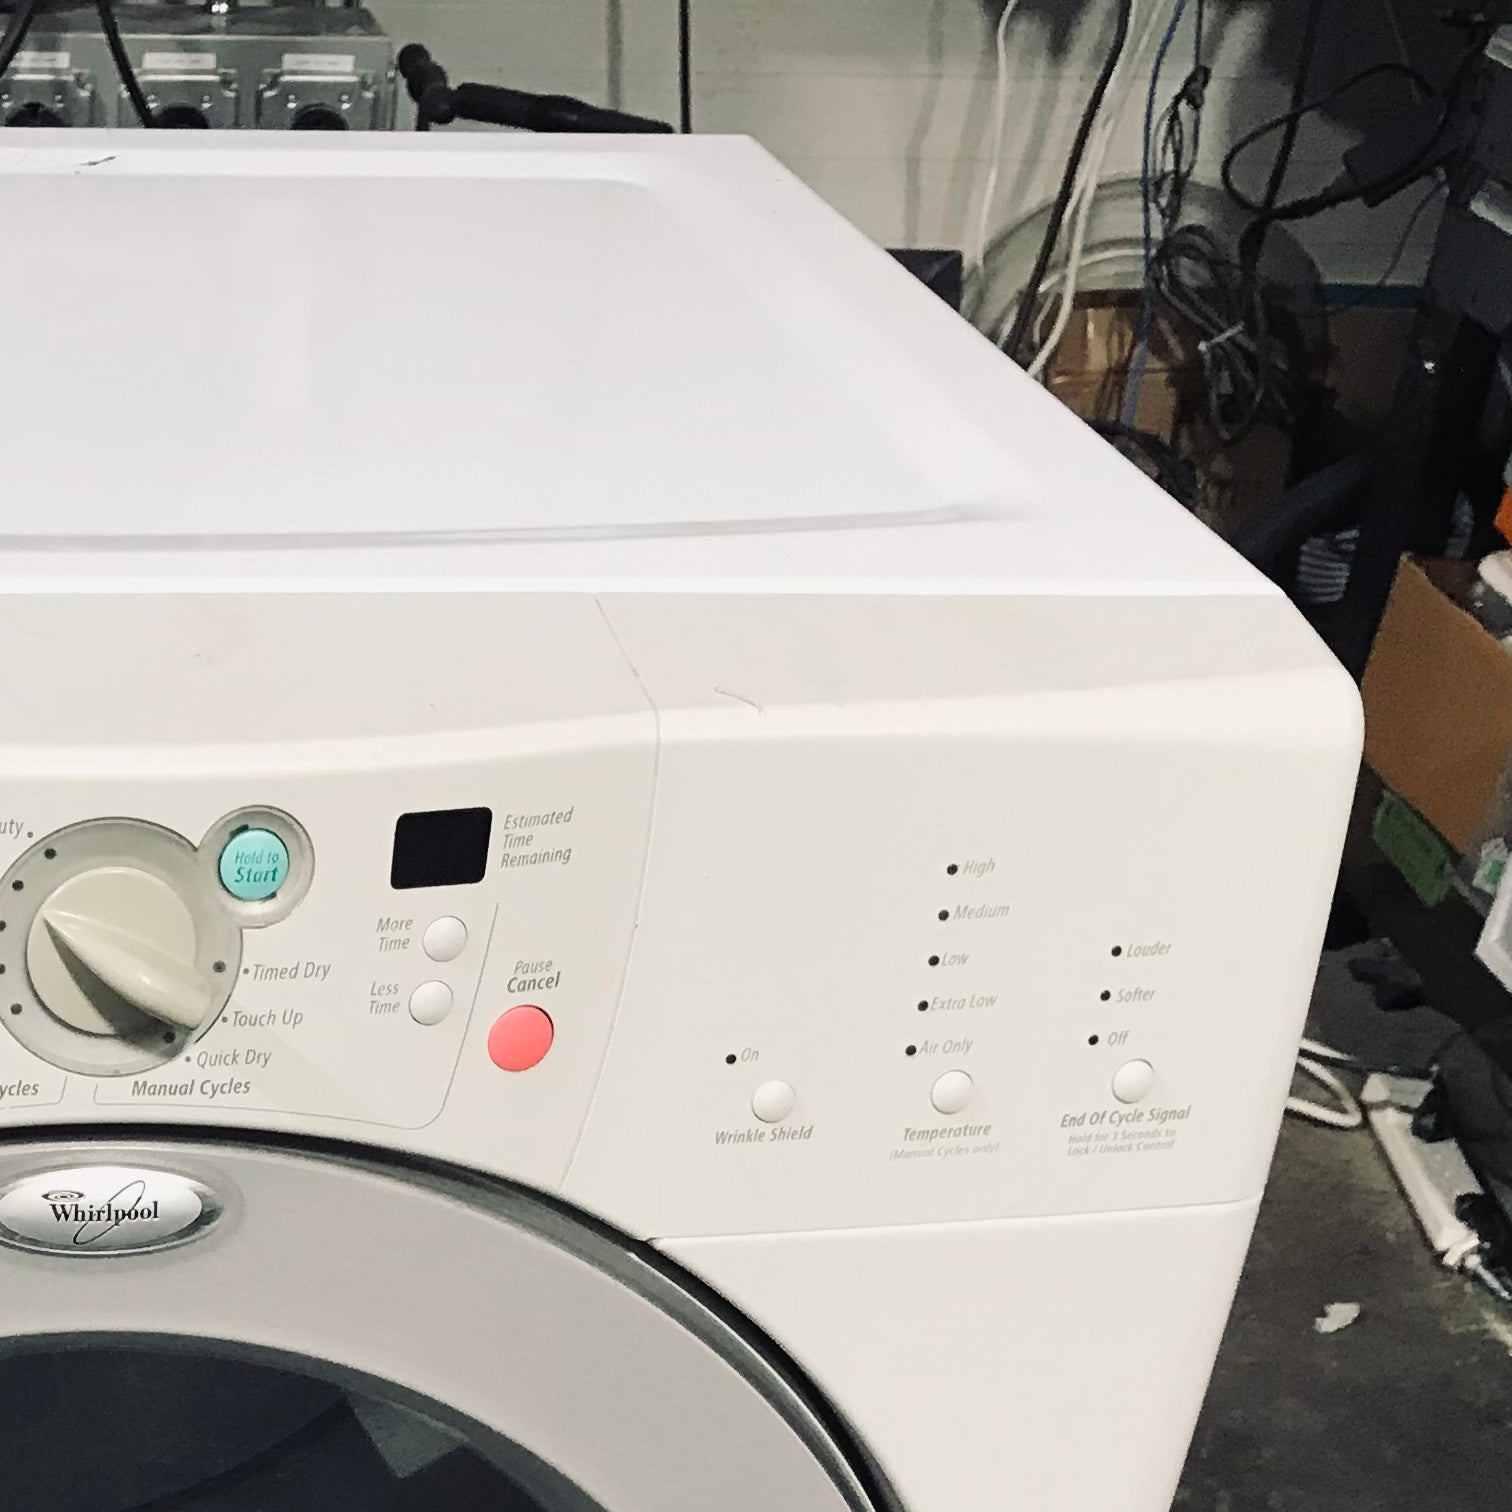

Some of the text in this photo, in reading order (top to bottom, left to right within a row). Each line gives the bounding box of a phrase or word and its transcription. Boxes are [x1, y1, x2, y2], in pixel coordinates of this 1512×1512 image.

[504, 806, 574, 830] Estimated
[503, 832, 533, 848] Time
[234, 851, 279, 865] Hold to
[500, 847, 572, 868] Remaining
[234, 866, 277, 884] Start
[963, 858, 995, 876] High
[953, 903, 1010, 920] Medium
[376, 918, 413, 933] More
[378, 936, 410, 952] Time
[1126, 941, 1173, 959] Louder
[514, 958, 552, 975] Pause
[942, 951, 969, 967] Low
[253, 962, 331, 982] Timed Dry
[370, 981, 399, 997] Less
[507, 972, 561, 993] Cancel
[931, 994, 998, 1012] Extra Low
[1116, 987, 1156, 1004] Softer
[369, 1000, 400, 1015] Time
[232, 1009, 304, 1028] Touch Up
[919, 1038, 973, 1057] Air Only
[1106, 1031, 1129, 1046] Off
[196, 1050, 271, 1068] Quick Dry
[740, 1047, 759, 1063] On
[131, 1078, 250, 1097] Manual Cycles
[1061, 1105, 1192, 1128] End Of Cycle Signal
[715, 1125, 814, 1146] Wrinkle Shield
[903, 1124, 992, 1142] Temperature
[889, 1142, 1000, 1161] (Manual Cycles only)
[49, 1201, 160, 1226] Whirlpool
